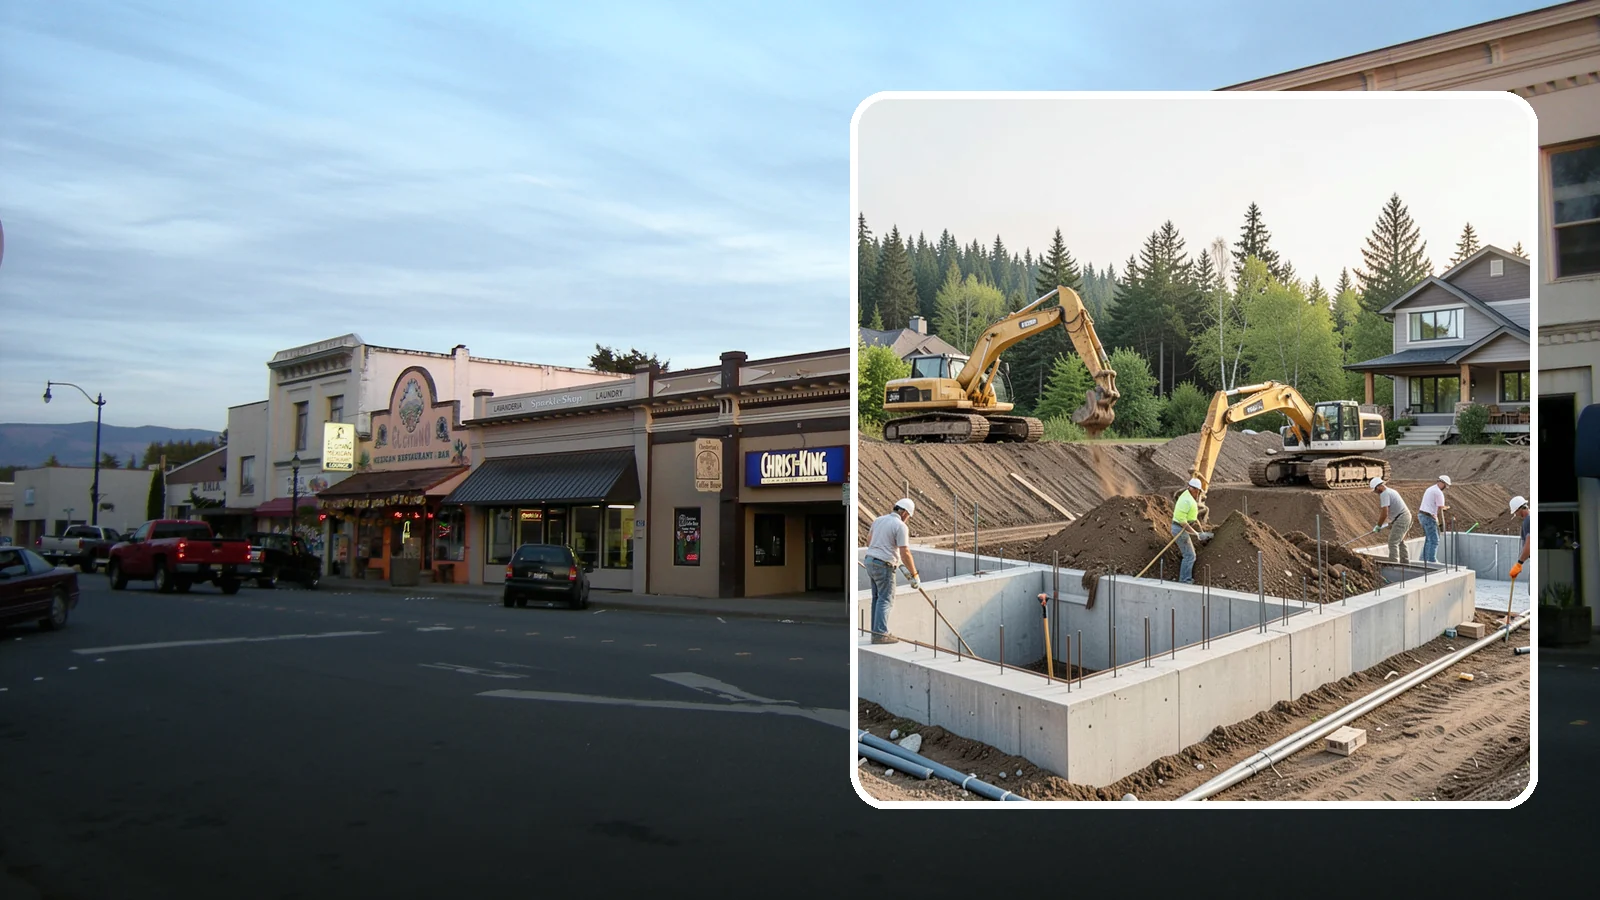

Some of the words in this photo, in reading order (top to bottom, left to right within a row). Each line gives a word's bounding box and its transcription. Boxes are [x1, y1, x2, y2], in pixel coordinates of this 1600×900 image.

[595, 388, 623, 400] LAUNDRY
[493, 402, 522, 413] LAVANDERIA
[530, 397, 561, 410] Sparkle
[562, 394, 582, 405] Shop
[373, 454, 396, 464] MEXICAN
[397, 451, 433, 462] RESTAURANT
[438, 450, 450, 459] BAR
[761, 452, 797, 478] CHRIST
[799, 449, 827, 476] KING
[696, 480, 709, 489] Coffee
[710, 480, 721, 489] House
